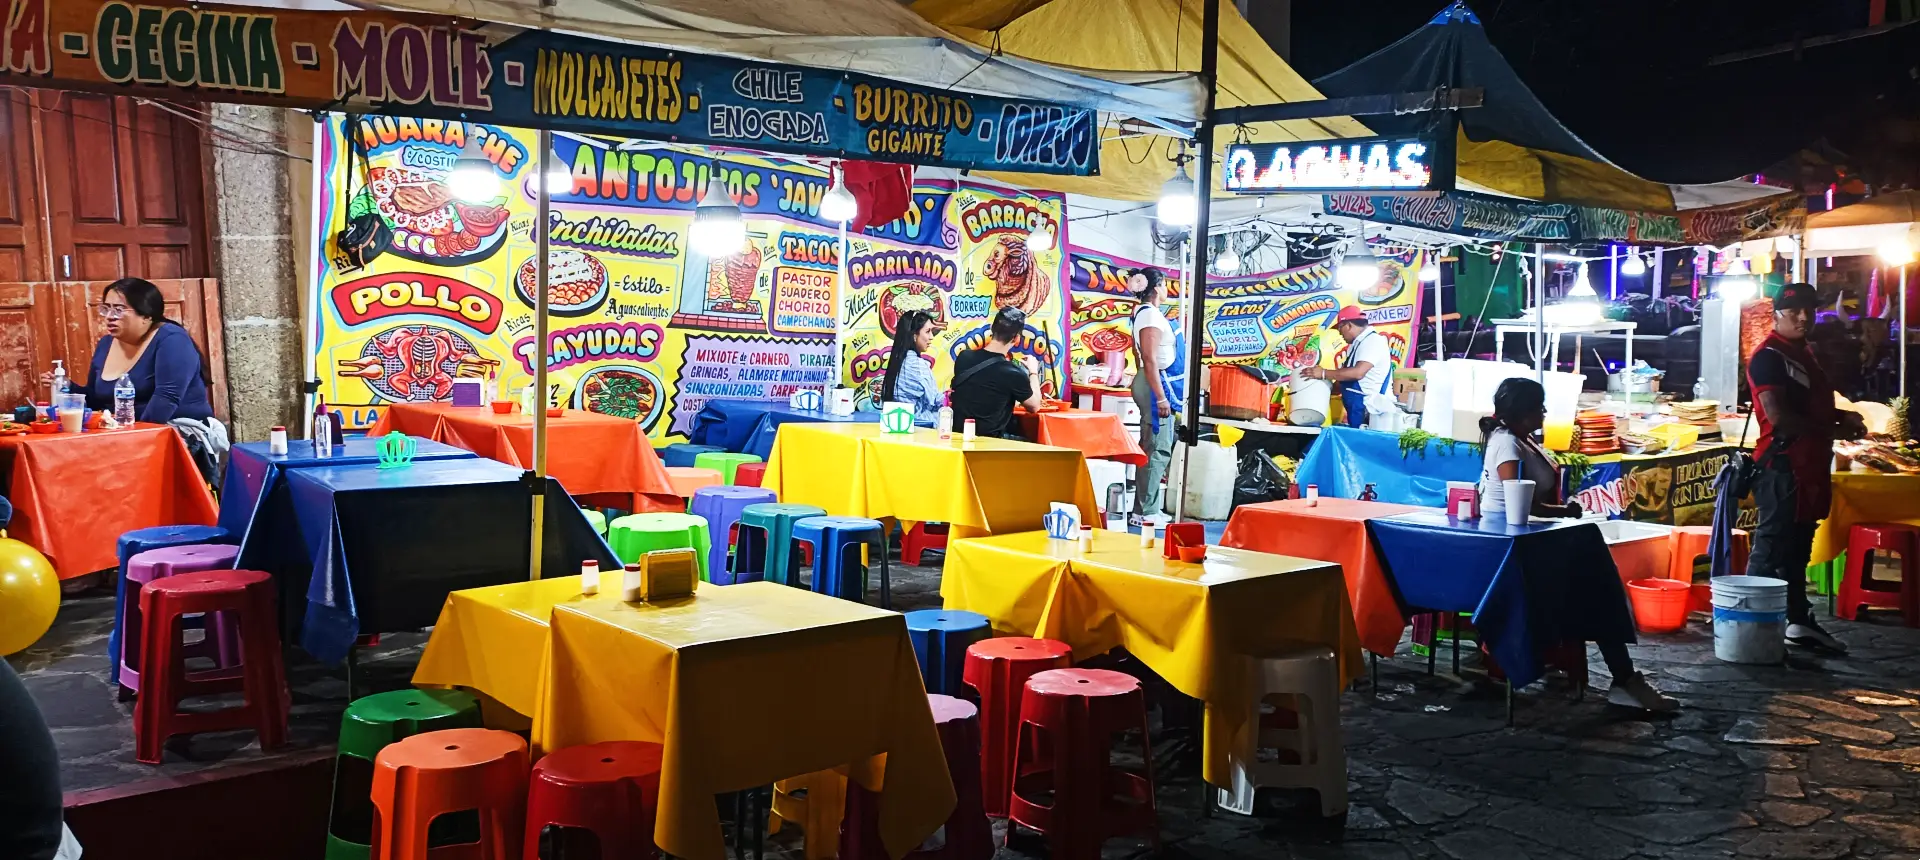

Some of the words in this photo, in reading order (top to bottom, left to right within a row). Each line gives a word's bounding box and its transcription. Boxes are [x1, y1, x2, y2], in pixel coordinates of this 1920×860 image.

[98, 2, 285, 93] CECINA
[330, 18, 492, 110] MOLE
[534, 47, 681, 122] MOLCAJETES
[732, 67, 803, 102] CHILE
[853, 83, 974, 130] BURRITO
[707, 104, 829, 143] ENOGADA
[867, 129, 945, 157] GIGANTE
[781, 236, 838, 266] TACOS
[851, 255, 954, 287] PARRILLADA
[760, 273, 769, 287] de
[782, 272, 832, 288] PASTOR
[350, 281, 492, 322] POLLO
[781, 286, 831, 301] SUADERO
[778, 300, 831, 315] CHORIZO
[843, 287, 878, 325] Mixta
[954, 300, 987, 313] BORREGO
[1219, 302, 1268, 317] TACOS
[1270, 298, 1335, 329] CHAMORROS
[1367, 308, 1409, 321] ARNERO
[504, 313, 531, 332] Ricas
[777, 314, 836, 328] CAMPECHANOS
[1211, 319, 1254, 328] PASTOR
[1213, 327, 1256, 336] SUADERO
[1216, 335, 1259, 345] CHORIZO
[517, 327, 660, 373] TAYUDAS
[695, 349, 739, 364] MIXIOTE
[749, 352, 793, 367] CARNERO,
[690, 366, 732, 382] GRINGAS,
[738, 368, 780, 381] ALAMBRE
[781, 369, 803, 382] MIXTO
[685, 382, 766, 398] SINCRONIZADAS,
